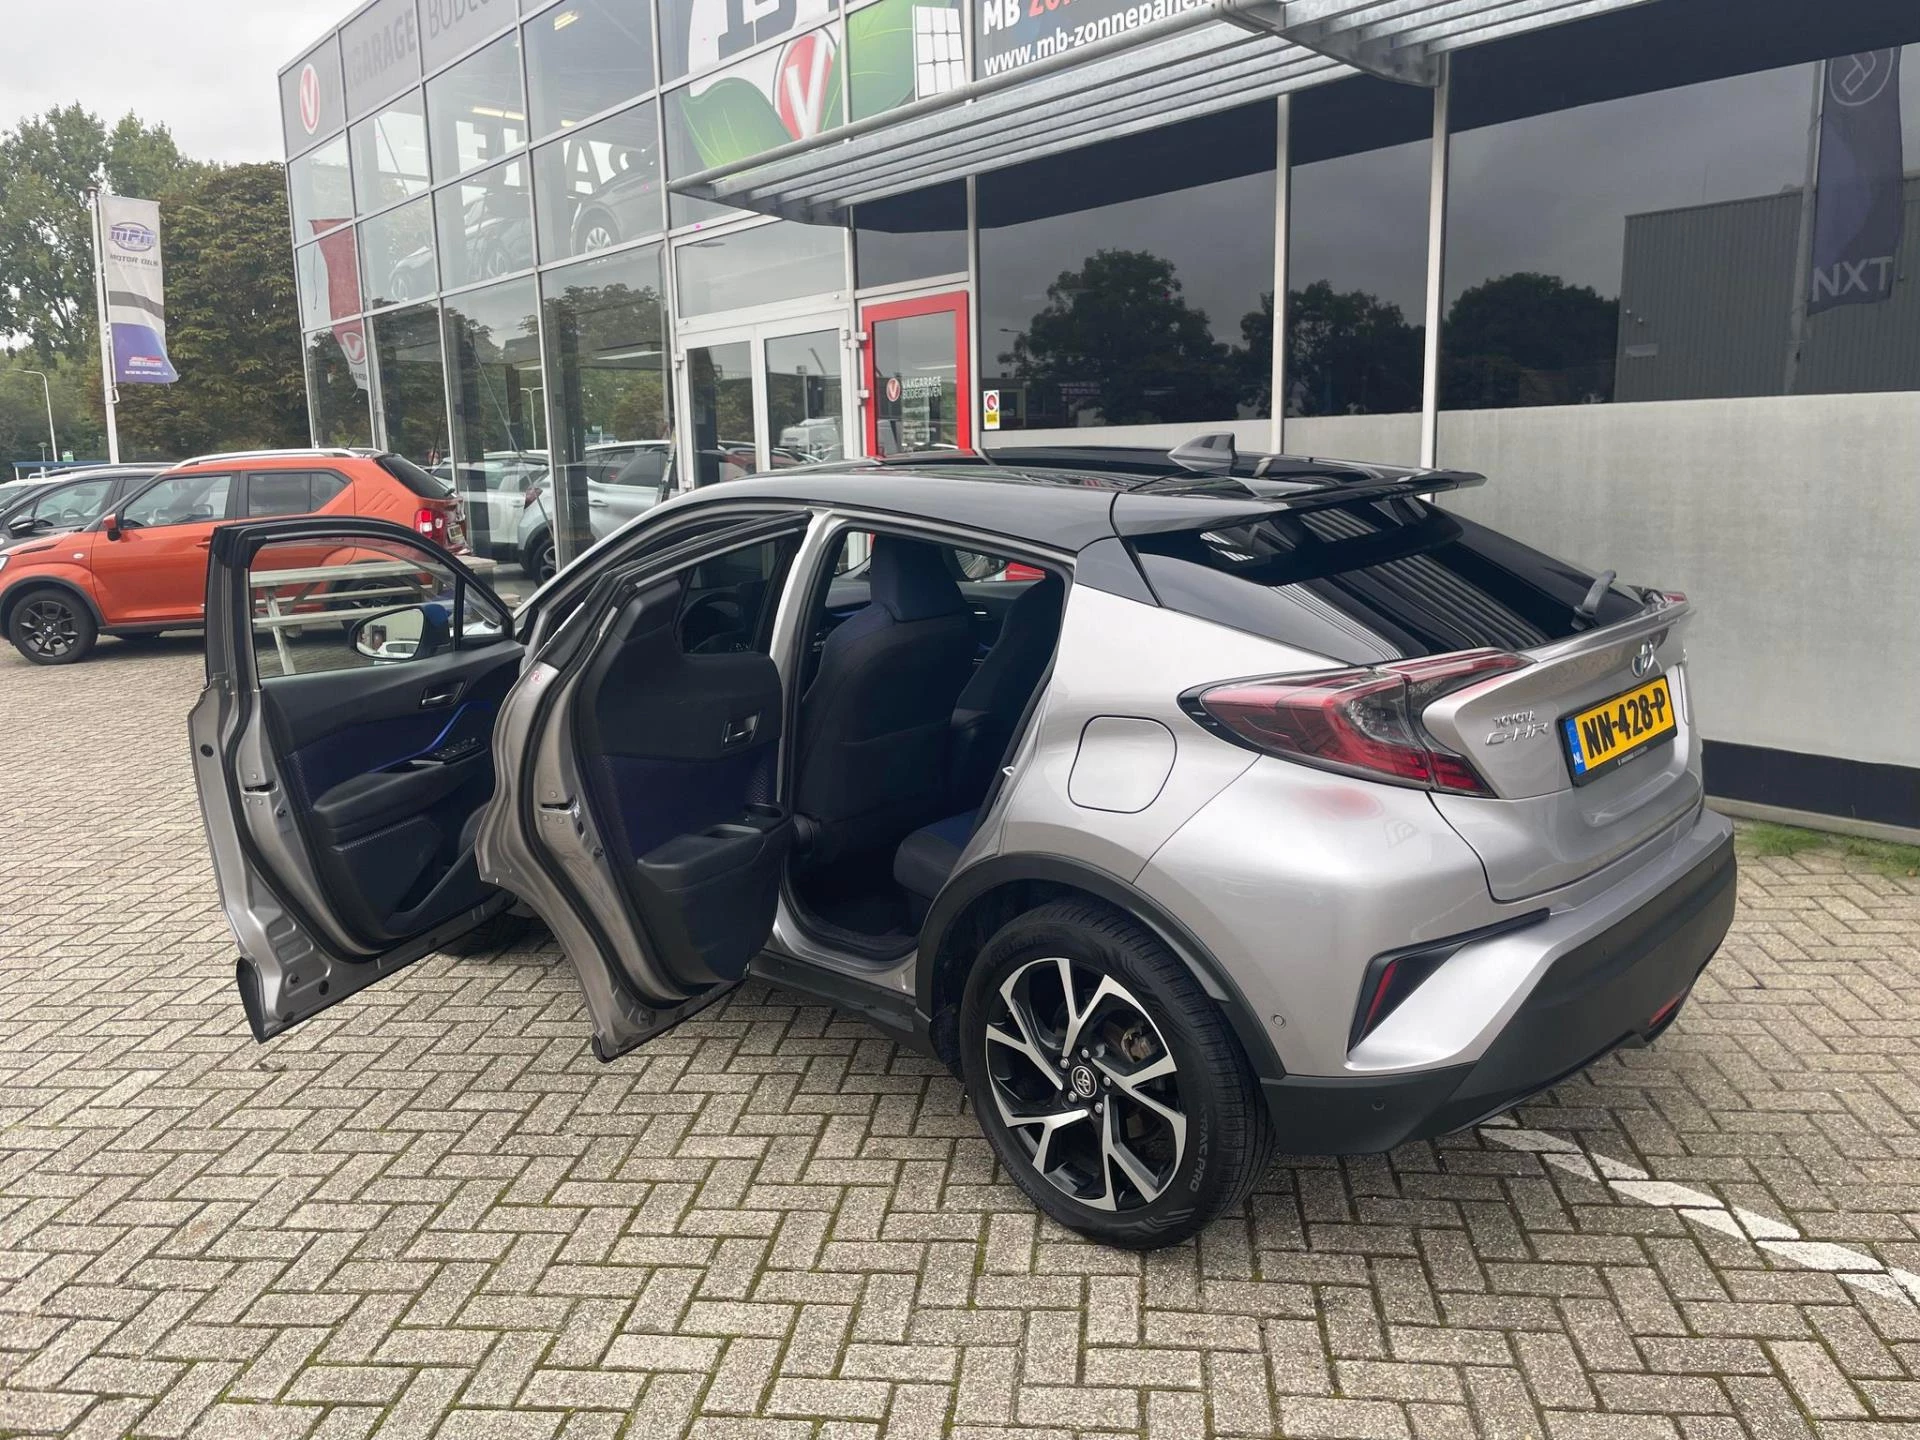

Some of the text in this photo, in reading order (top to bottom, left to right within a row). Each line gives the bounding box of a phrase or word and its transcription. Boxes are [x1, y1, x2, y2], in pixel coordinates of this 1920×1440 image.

[983, 0, 1021, 35] MB
[1812, 256, 1893, 303] NXT
[901, 376, 942, 389] VAKGARAGE
[1493, 709, 1535, 726] TOYOTA
[1582, 687, 1666, 759] NN-428-P
[1573, 753, 1584, 766] NL
